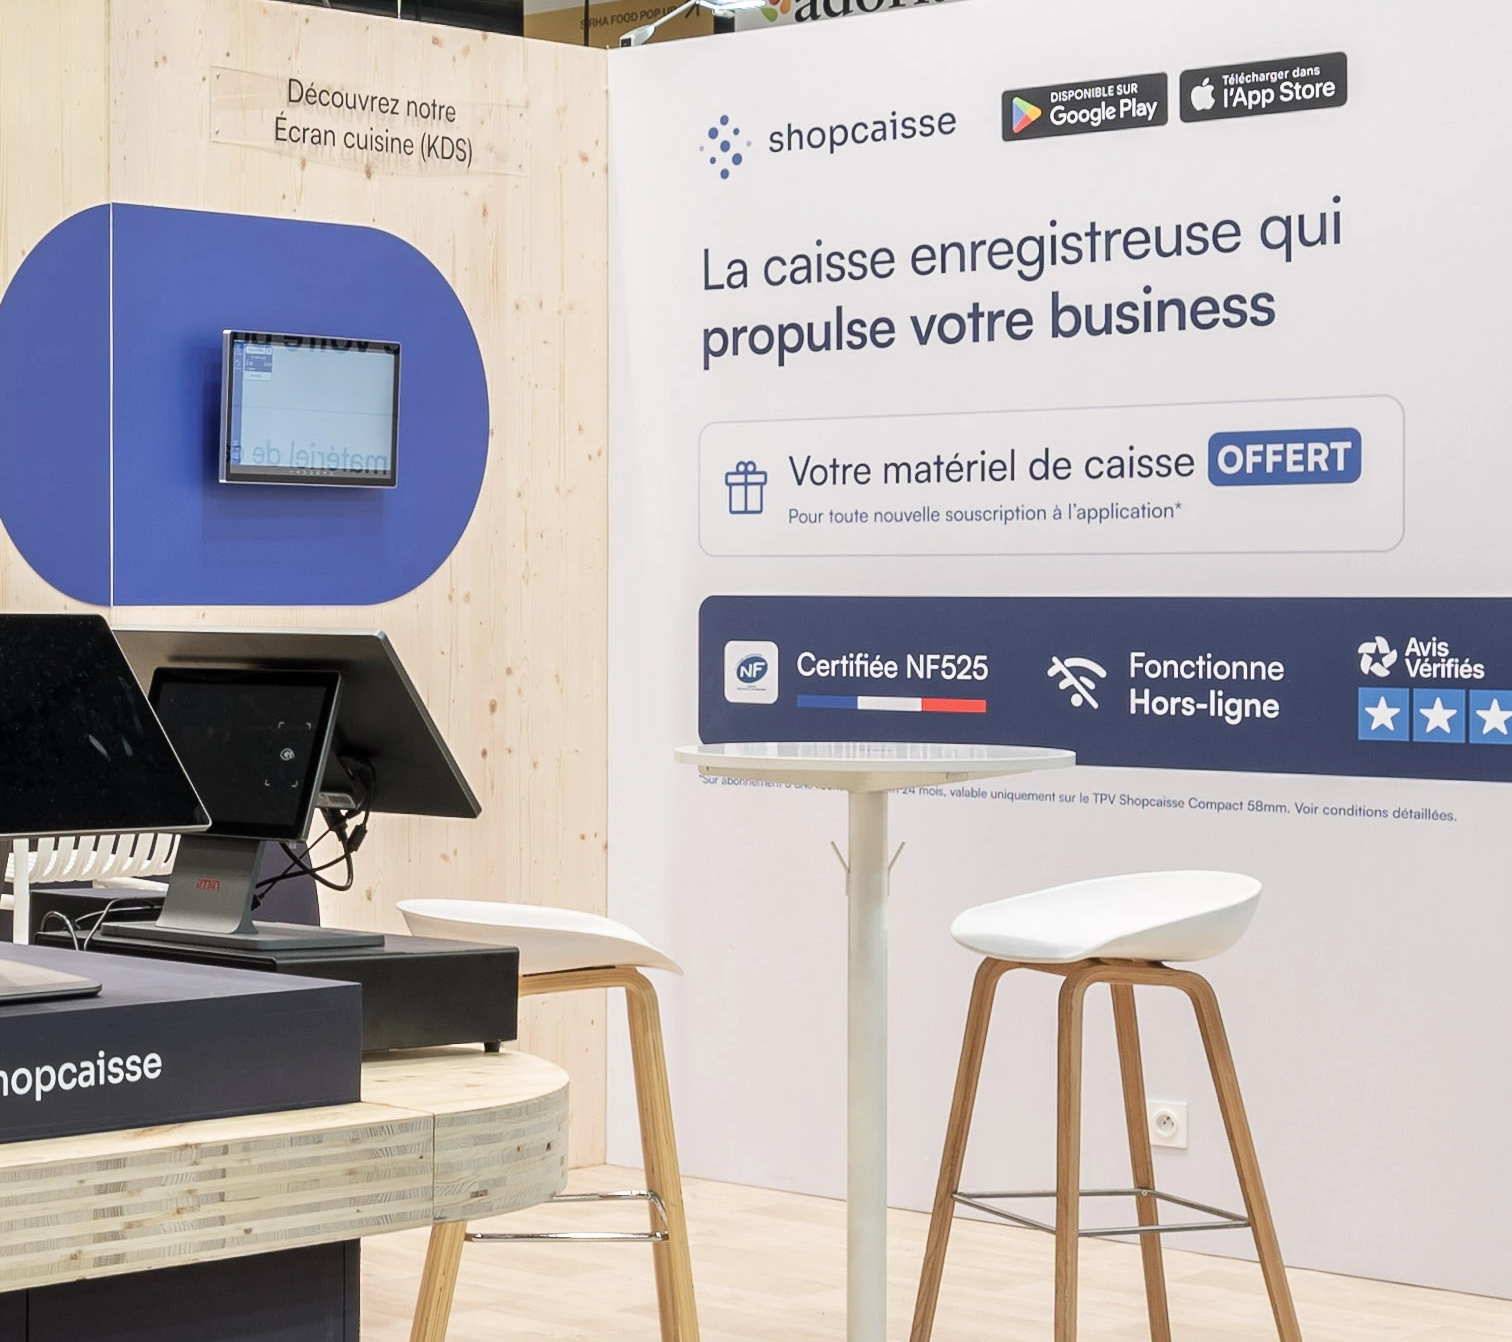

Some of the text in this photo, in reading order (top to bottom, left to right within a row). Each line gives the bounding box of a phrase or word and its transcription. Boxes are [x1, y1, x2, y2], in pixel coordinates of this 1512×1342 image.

[580, 17, 609, 30] SRHA
[611, 11, 638, 25] FOOD
[640, 8, 660, 21] POP
[1222, 64, 1321, 87] Télécharger dans
[1278, 77, 1336, 103] Store
[287, 78, 457, 124] Découvrez notre
[1050, 81, 1139, 103] DISPONIBLE SUR
[1050, 96, 1158, 129] Google Play
[275, 112, 473, 169] Écran cuisine (KDS)
[768, 111, 958, 155] shopcaisse
[702, 195, 1343, 291] La caisse enregistreuse qui
[702, 285, 1276, 370] propulse votre business
[788, 440, 1353, 487] Votre matériel de caisse OFFERT
[788, 507, 824, 525] Pour
[828, 507, 869, 524] toute
[873, 504, 941, 523] nouvelle
[945, 503, 1048, 526] souscription
[1052, 503, 1064, 520] à
[1404, 636, 1449, 657] Avis
[739, 661, 767, 678] NF
[796, 651, 989, 681] Certifiée NF525
[1130, 651, 1285, 682] Fonctionne
[1405, 656, 1485, 679] Vérifiés
[1130, 688, 1280, 726] Hors-ligne
[950, 787, 987, 799] valable
[991, 788, 1056, 804] uniquement
[1059, 792, 1077, 804] sur
[1080, 791, 1090, 804] le
[1093, 792, 1117, 805] TPV
[1119, 793, 1185, 811] Shopcaisse
[1189, 797, 1244, 813] Compact
[1247, 799, 1291, 814] 58mm.
[1295, 801, 1320, 816] Voir
[1323, 803, 1389, 819] conditions
[1392, 805, 1458, 823] détaillées.
